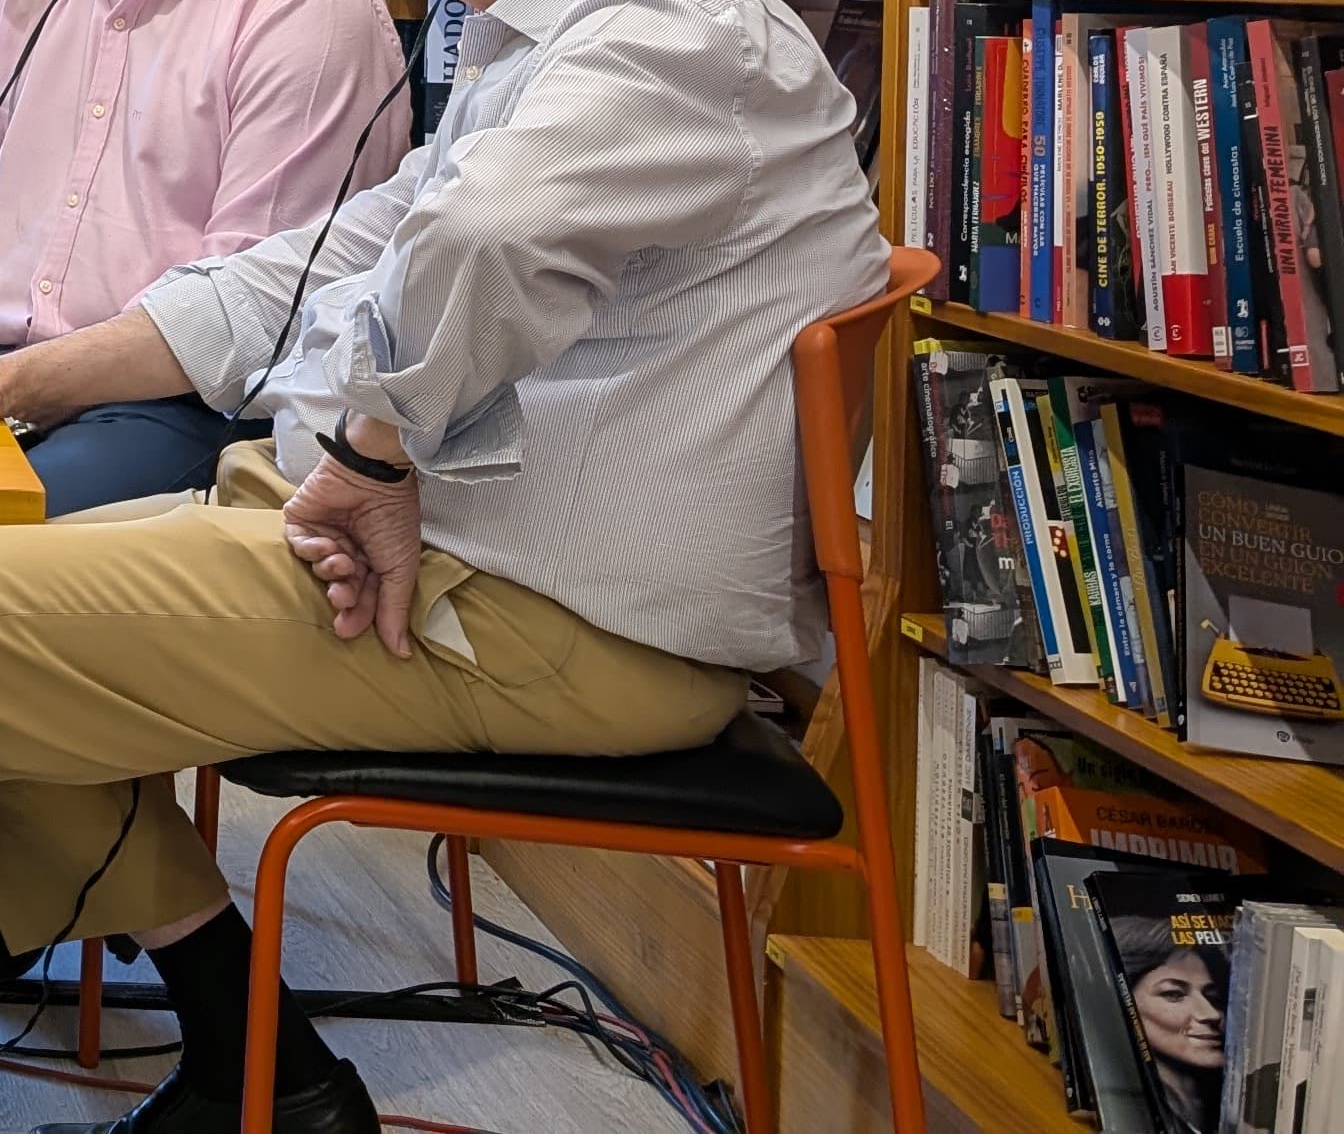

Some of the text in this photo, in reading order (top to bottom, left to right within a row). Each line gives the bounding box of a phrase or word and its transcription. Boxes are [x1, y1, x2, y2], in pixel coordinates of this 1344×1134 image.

[1139, 100, 1148, 120] PAÍS
[1193, 78, 1211, 141] WESTERN
[1034, 135, 1046, 157] 50
[1095, 111, 1105, 175] 1950-1959
[1159, 53, 1177, 258] VICENTE BOISSEAU HOLLYWOOD CONTRA ESPAÑA
[1263, 125, 1287, 195] FEMENINA
[960, 110, 972, 241] Correspondencia escogida
[1146, 199, 1154, 226] VIDAL
[1230, 145, 1245, 262] Escuela de cineastas
[1273, 197, 1293, 245] MIRADA
[1097, 236, 1107, 253] DE
[1148, 227, 1157, 269] SÁNCHEZ
[1278, 249, 1296, 275] UNA
[1097, 256, 1108, 288] CINE
[1151, 271, 1159, 312] AGUSTÍN
[920, 362, 937, 458] arte cinematográfico
[1060, 445, 1080, 495] EXORCISTA
[1092, 473, 1105, 508] Alberto
[1198, 524, 1228, 543] UN
[1232, 529, 1286, 557] BUEN
[1088, 567, 1099, 607] KARRAS
[1171, 912, 1190, 929] ASÍ
[1191, 914, 1209, 929] SE
